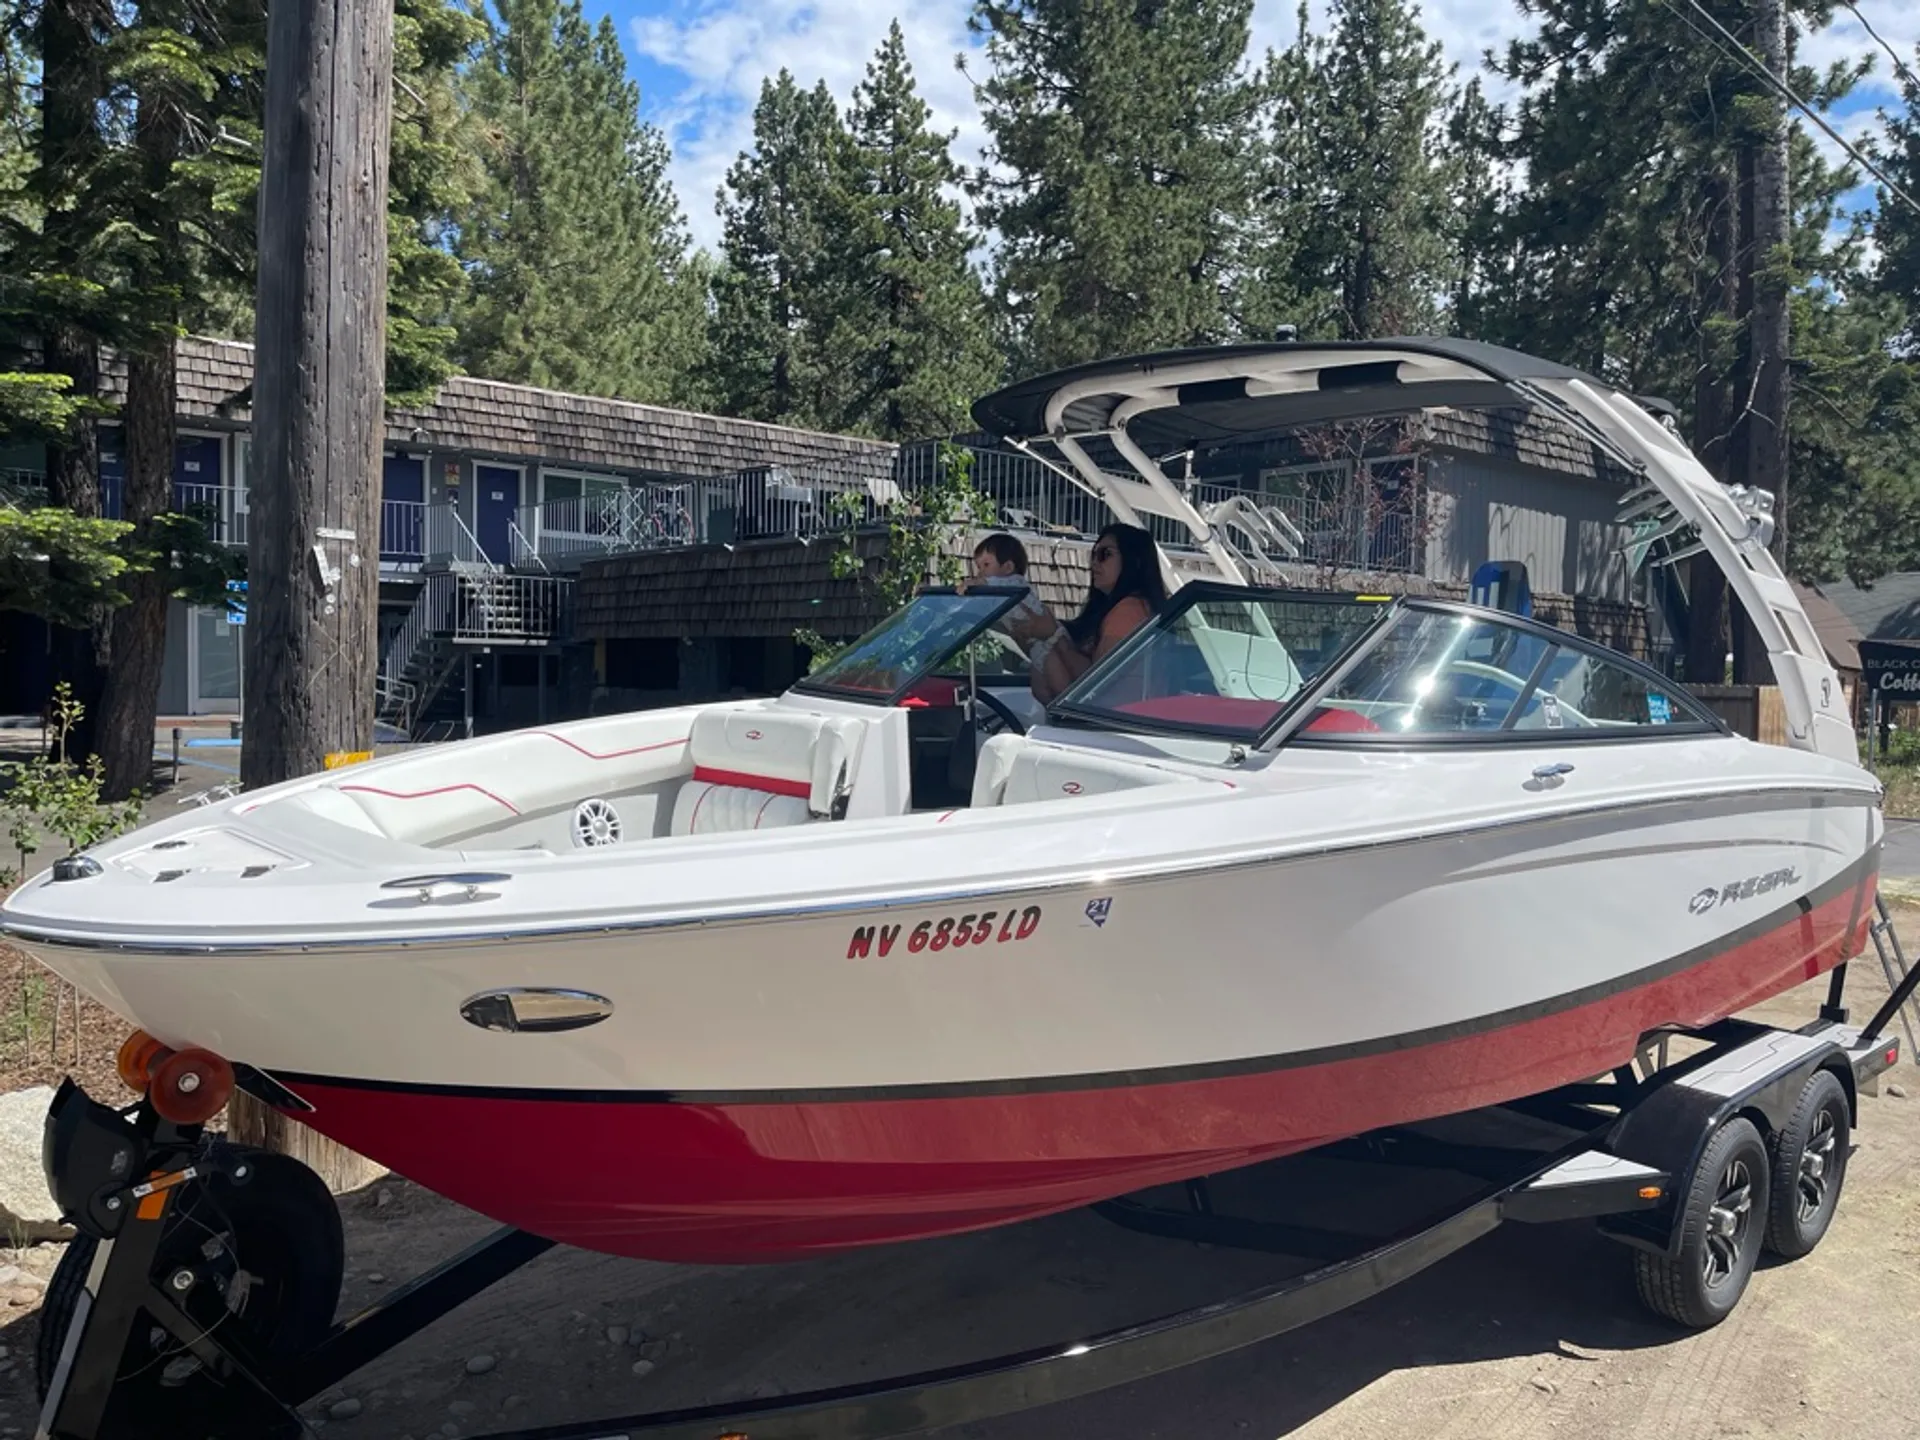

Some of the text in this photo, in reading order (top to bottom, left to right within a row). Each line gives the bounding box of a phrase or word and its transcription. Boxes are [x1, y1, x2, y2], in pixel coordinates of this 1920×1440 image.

[1867, 659, 1908, 668] BLACK
[1719, 865, 1802, 908] REGAL
[1088, 899, 1109, 913] 21
[847, 905, 1042, 959] NV 6855 LD
